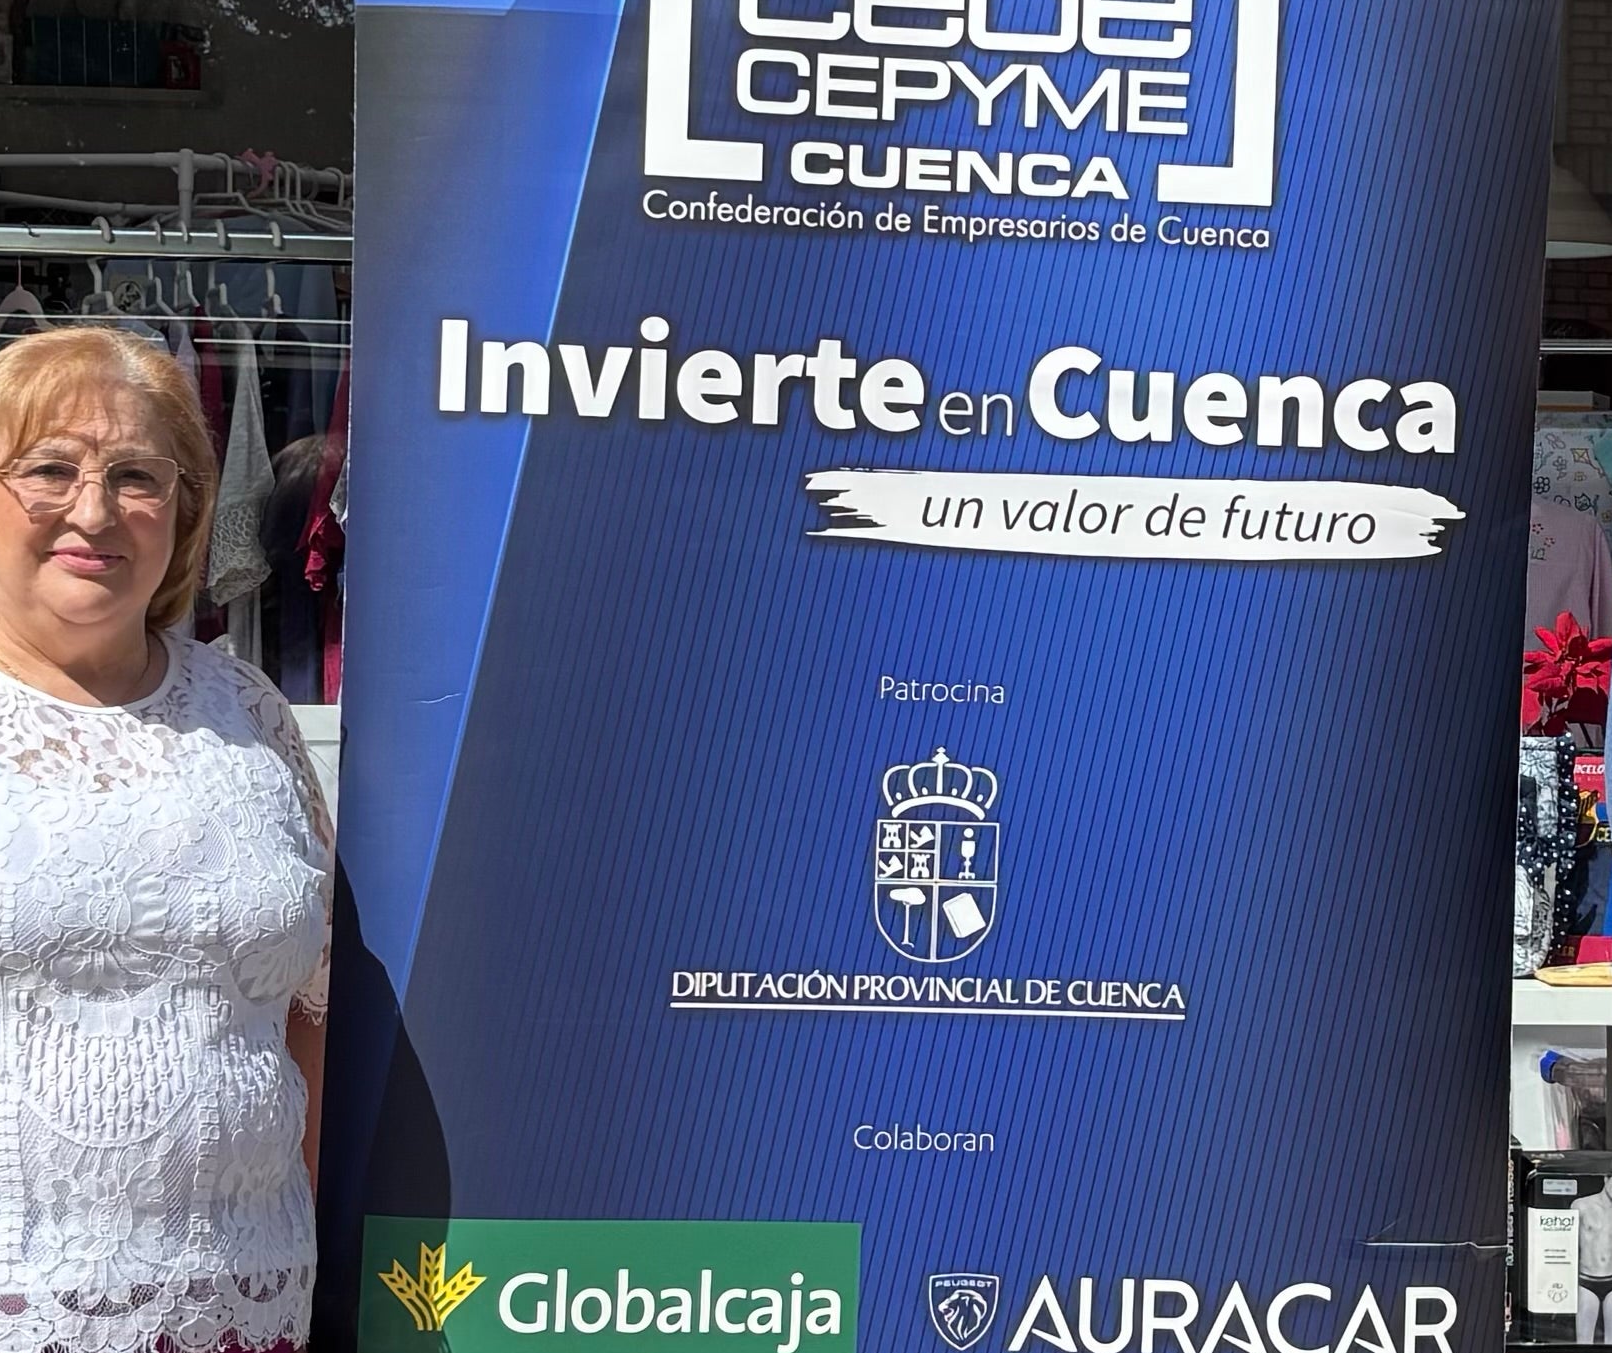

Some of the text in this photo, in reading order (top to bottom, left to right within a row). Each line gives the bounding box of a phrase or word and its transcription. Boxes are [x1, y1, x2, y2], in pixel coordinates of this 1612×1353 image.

[735, 47, 1190, 136] CEPYME
[789, 140, 1130, 200] CUENCA
[641, 188, 1271, 250] Confederación de Empresarios de Cuenca
[435, 315, 1458, 456] Invierte en Cuenca
[920, 488, 1378, 549] un valor de futuro
[878, 674, 1007, 706] Patrocina
[671, 968, 1186, 1010] DIPUTACIÓN PROVINCIAL DE CUENCA
[852, 1123, 996, 1153] Colaboran
[496, 1269, 843, 1353] Globalcaja
[934, 1279, 994, 1288] PEUGEOT
